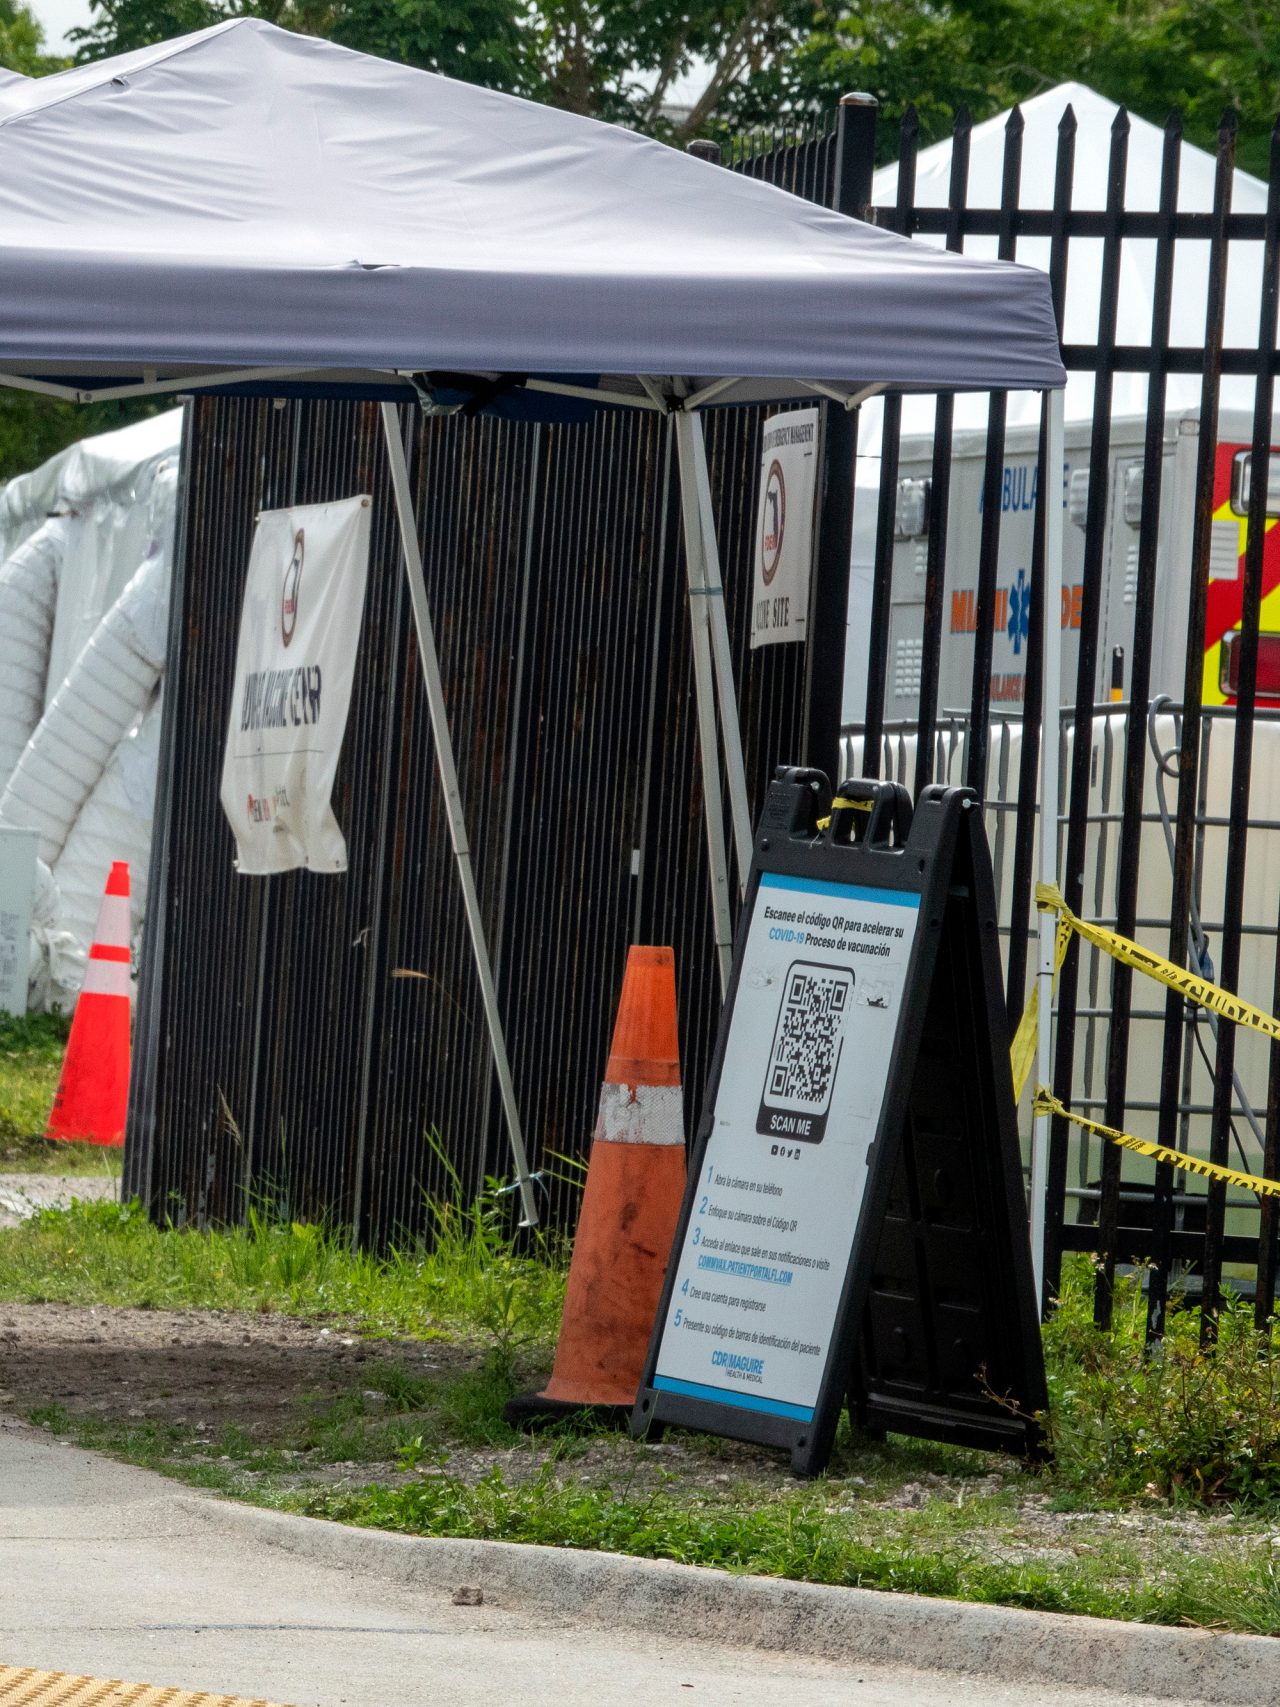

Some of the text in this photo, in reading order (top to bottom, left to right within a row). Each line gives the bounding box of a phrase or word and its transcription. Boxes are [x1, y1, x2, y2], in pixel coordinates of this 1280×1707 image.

[773, 597, 789, 628] SITE
[764, 906, 904, 938] Escanee el código QR para acelerar su
[769, 927, 890, 957] COVID-19 Proceso de vacunación
[770, 1114, 812, 1136] SCAN ME
[708, 1165, 714, 1183] 1
[726, 1175, 732, 1187] la
[749, 1181, 756, 1191] en
[756, 1183, 763, 1193] su
[699, 1196, 708, 1215] 2
[708, 1204, 728, 1220] Enfoque
[728, 1210, 735, 1220] su
[752, 1211, 766, 1226] sobre
[766, 1215, 772, 1227] el
[789, 1220, 798, 1232] QR
[692, 1227, 701, 1245] 3
[724, 1240, 741, 1253] enlace
[740, 1245, 751, 1257] que
[751, 1246, 762, 1258] sale
[761, 1249, 768, 1259] en
[768, 1250, 778, 1261] sus
[778, 1250, 812, 1267] notificaciones
[681, 1278, 767, 1312] 4 Cree una cuenta para registrarse
[673, 1308, 683, 1327] 5
[683, 1317, 705, 1333] Presente
[704, 1323, 711, 1333] su
[727, 1326, 736, 1338] de
[735, 1327, 751, 1342] barras
[751, 1331, 759, 1344] de
[791, 1338, 800, 1351] del
[798, 1342, 821, 1356] paciente
[746, 1373, 763, 1384] MEDICAL
